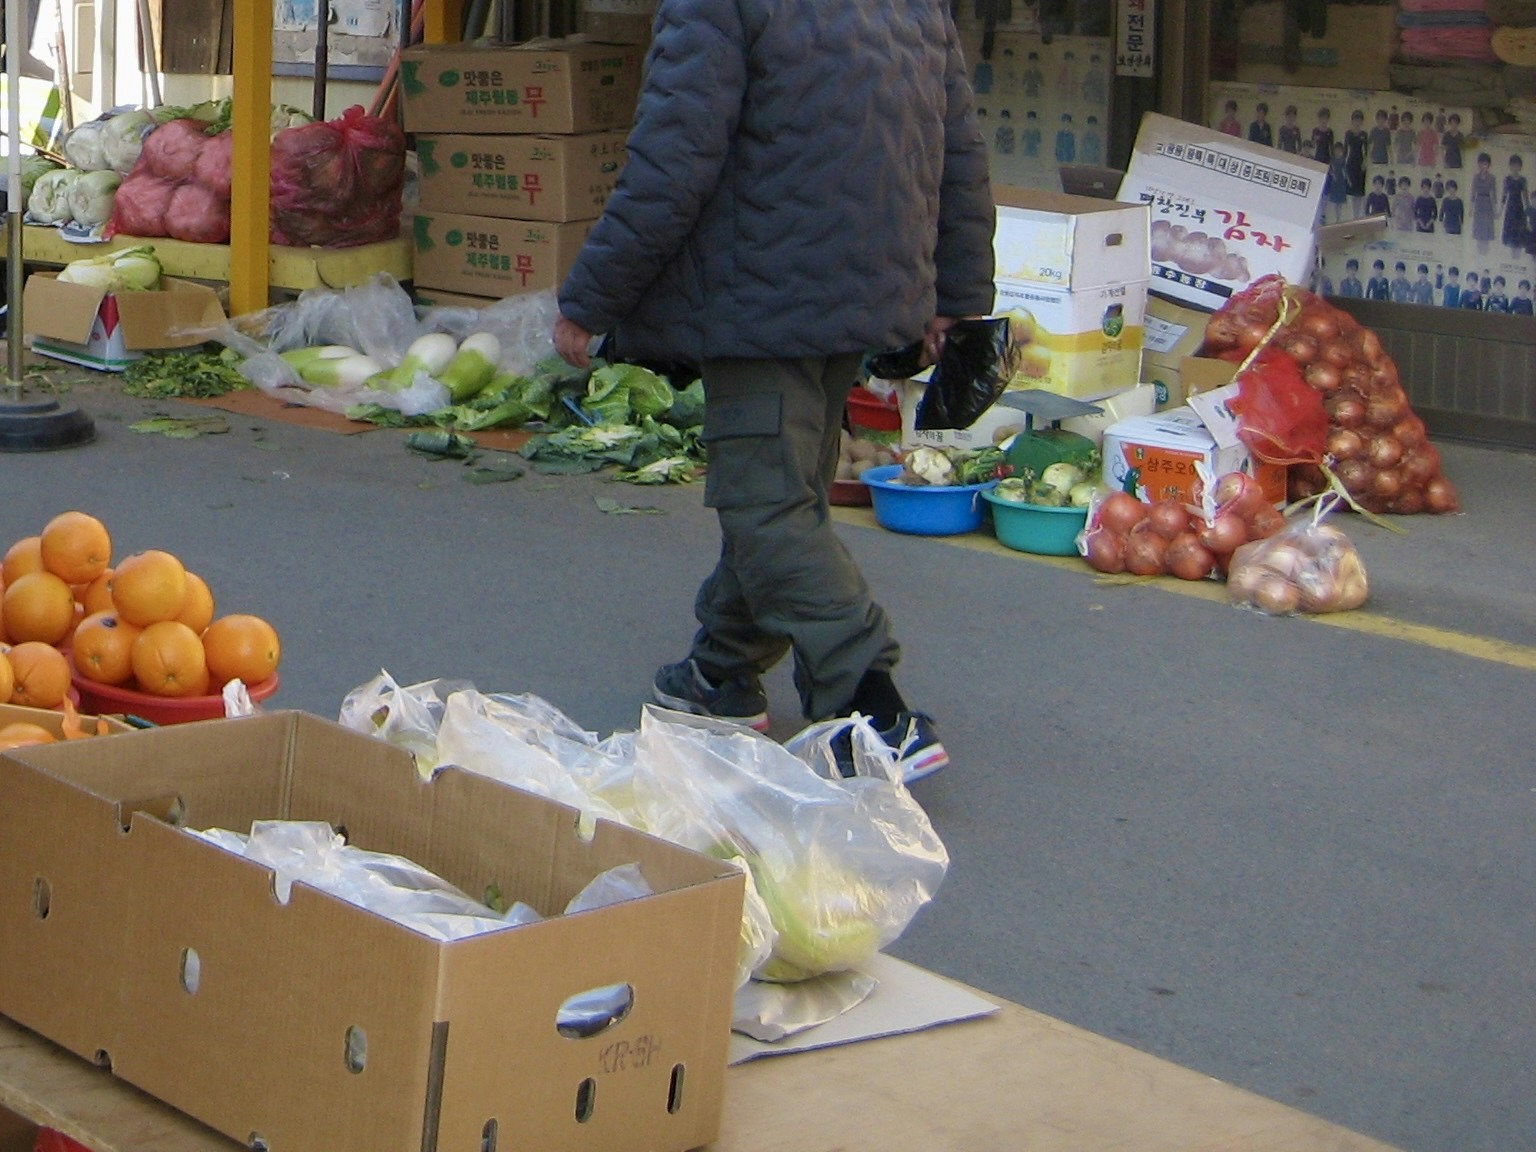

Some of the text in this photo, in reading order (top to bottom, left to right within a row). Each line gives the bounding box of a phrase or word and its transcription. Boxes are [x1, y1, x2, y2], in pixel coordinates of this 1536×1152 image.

[521, 86, 547, 118] 무
[521, 173, 544, 206] 무
[1212, 208, 1294, 253] 감자
[515, 253, 536, 288] 무
[1038, 266, 1063, 281] 20kg
